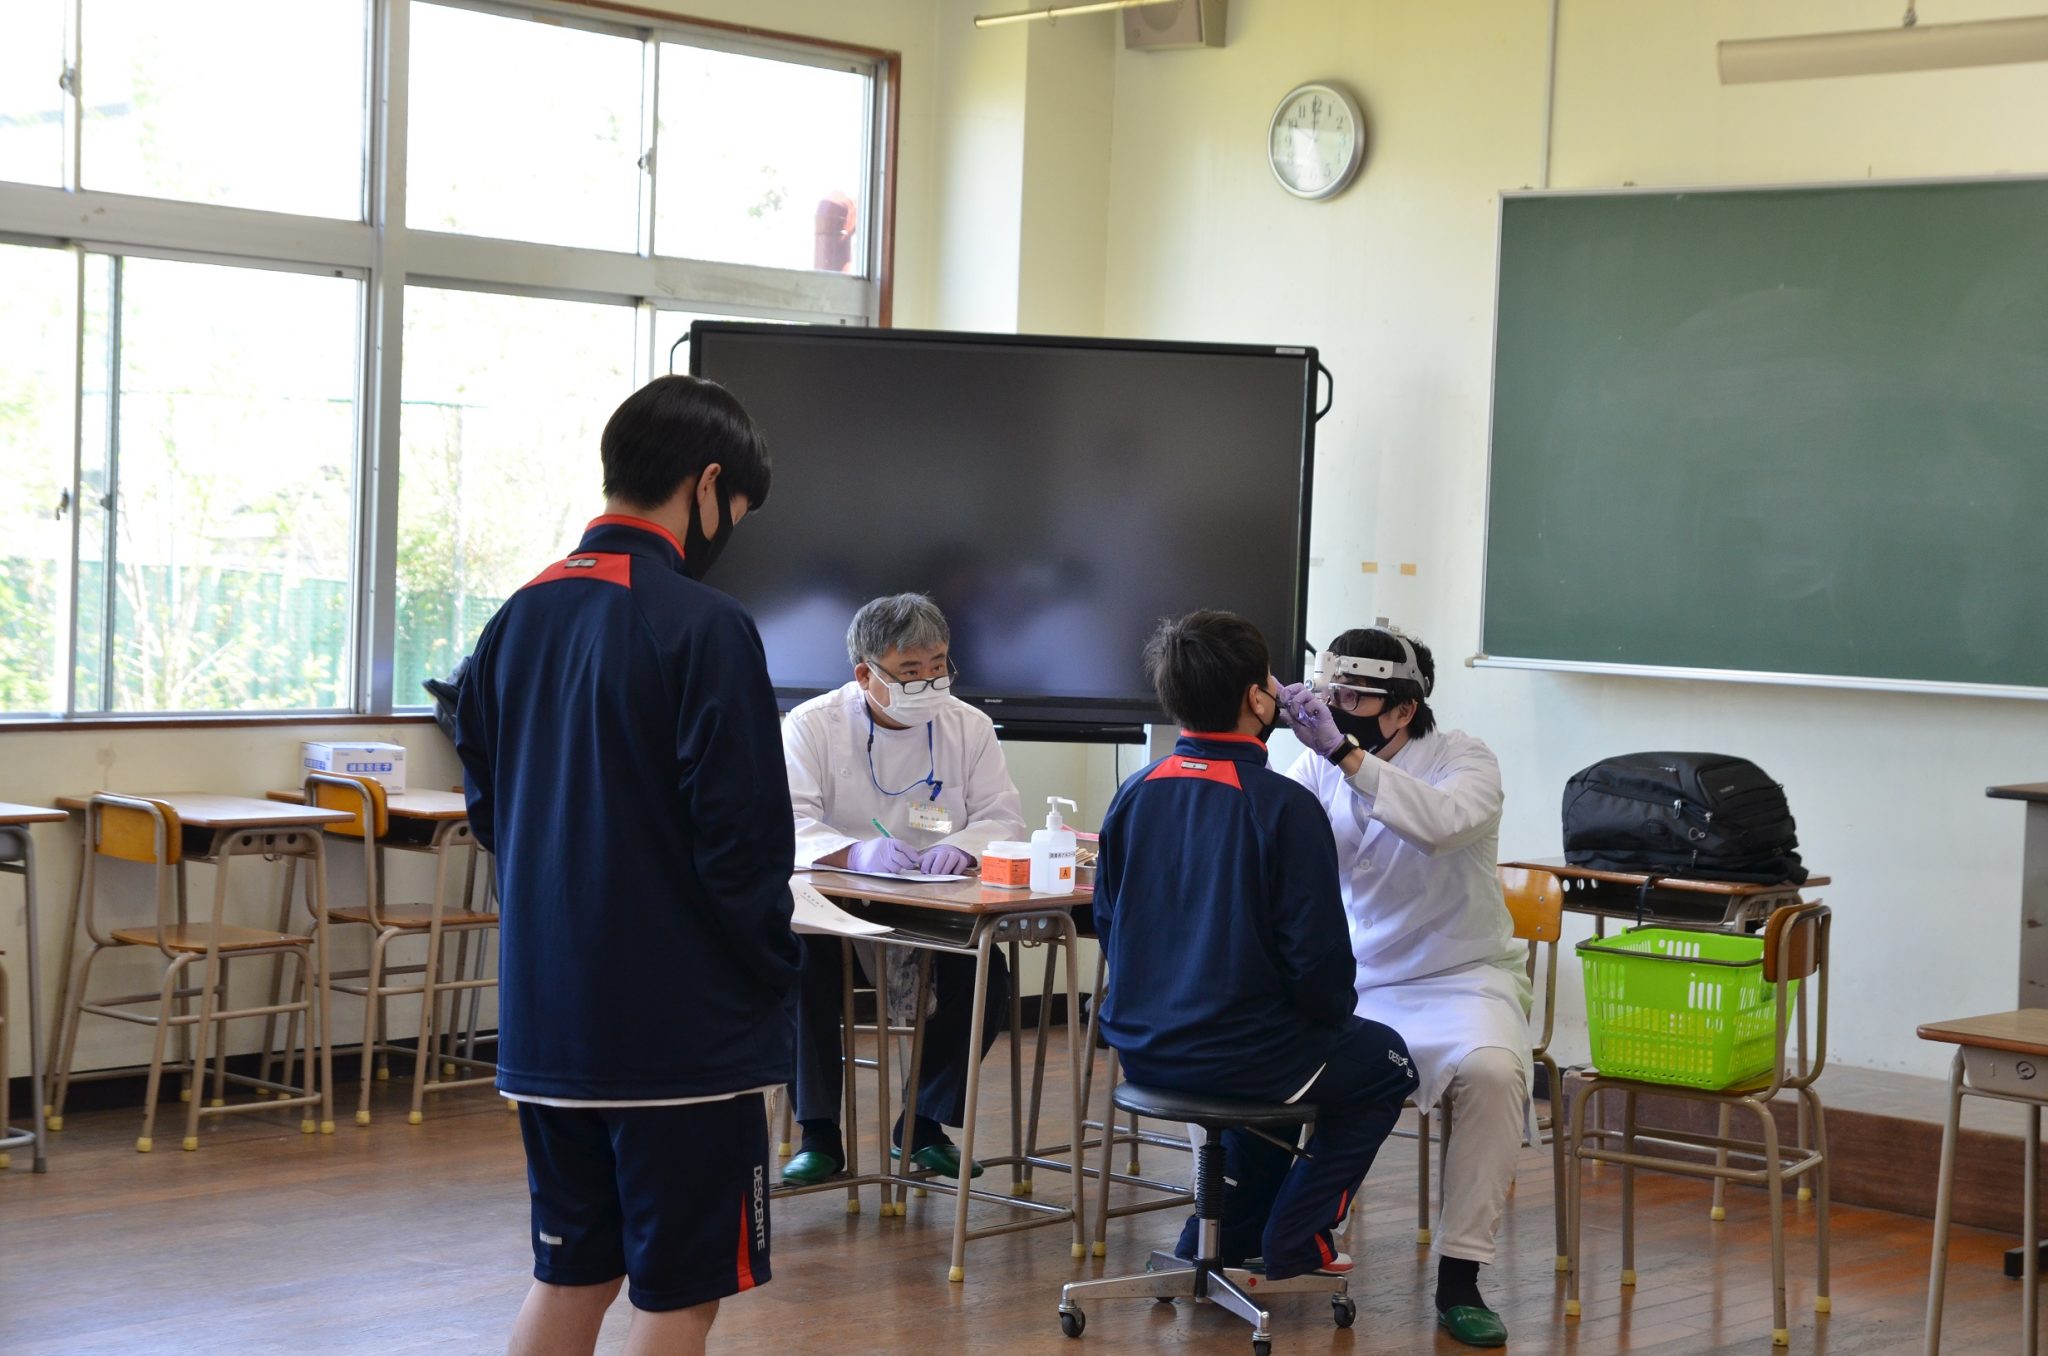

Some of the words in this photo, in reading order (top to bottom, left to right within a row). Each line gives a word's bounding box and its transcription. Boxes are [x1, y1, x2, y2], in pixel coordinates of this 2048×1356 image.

[1297, 103, 1306, 119] 11
[1336, 116, 1344, 130] 2
[1388, 1049, 1414, 1078] DESCEE
[753, 1164, 766, 1252] DESCENTE
